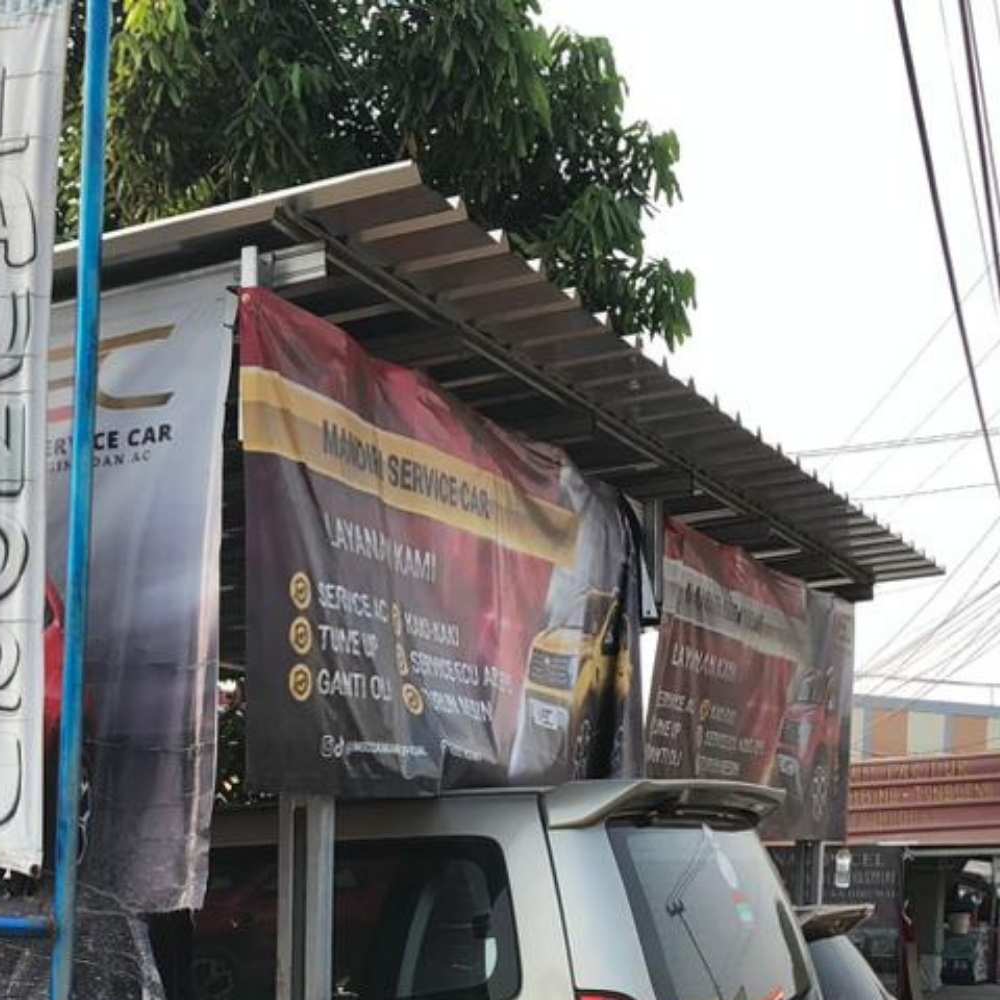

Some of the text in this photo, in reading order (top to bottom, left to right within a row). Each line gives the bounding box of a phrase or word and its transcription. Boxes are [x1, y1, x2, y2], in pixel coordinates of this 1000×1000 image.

[128, 424, 172, 448] CAR
[322, 418, 490, 520] MANDIRI SERVICE CAR
[394, 542, 437, 584] KAMI
[317, 668, 367, 700] GANTI
